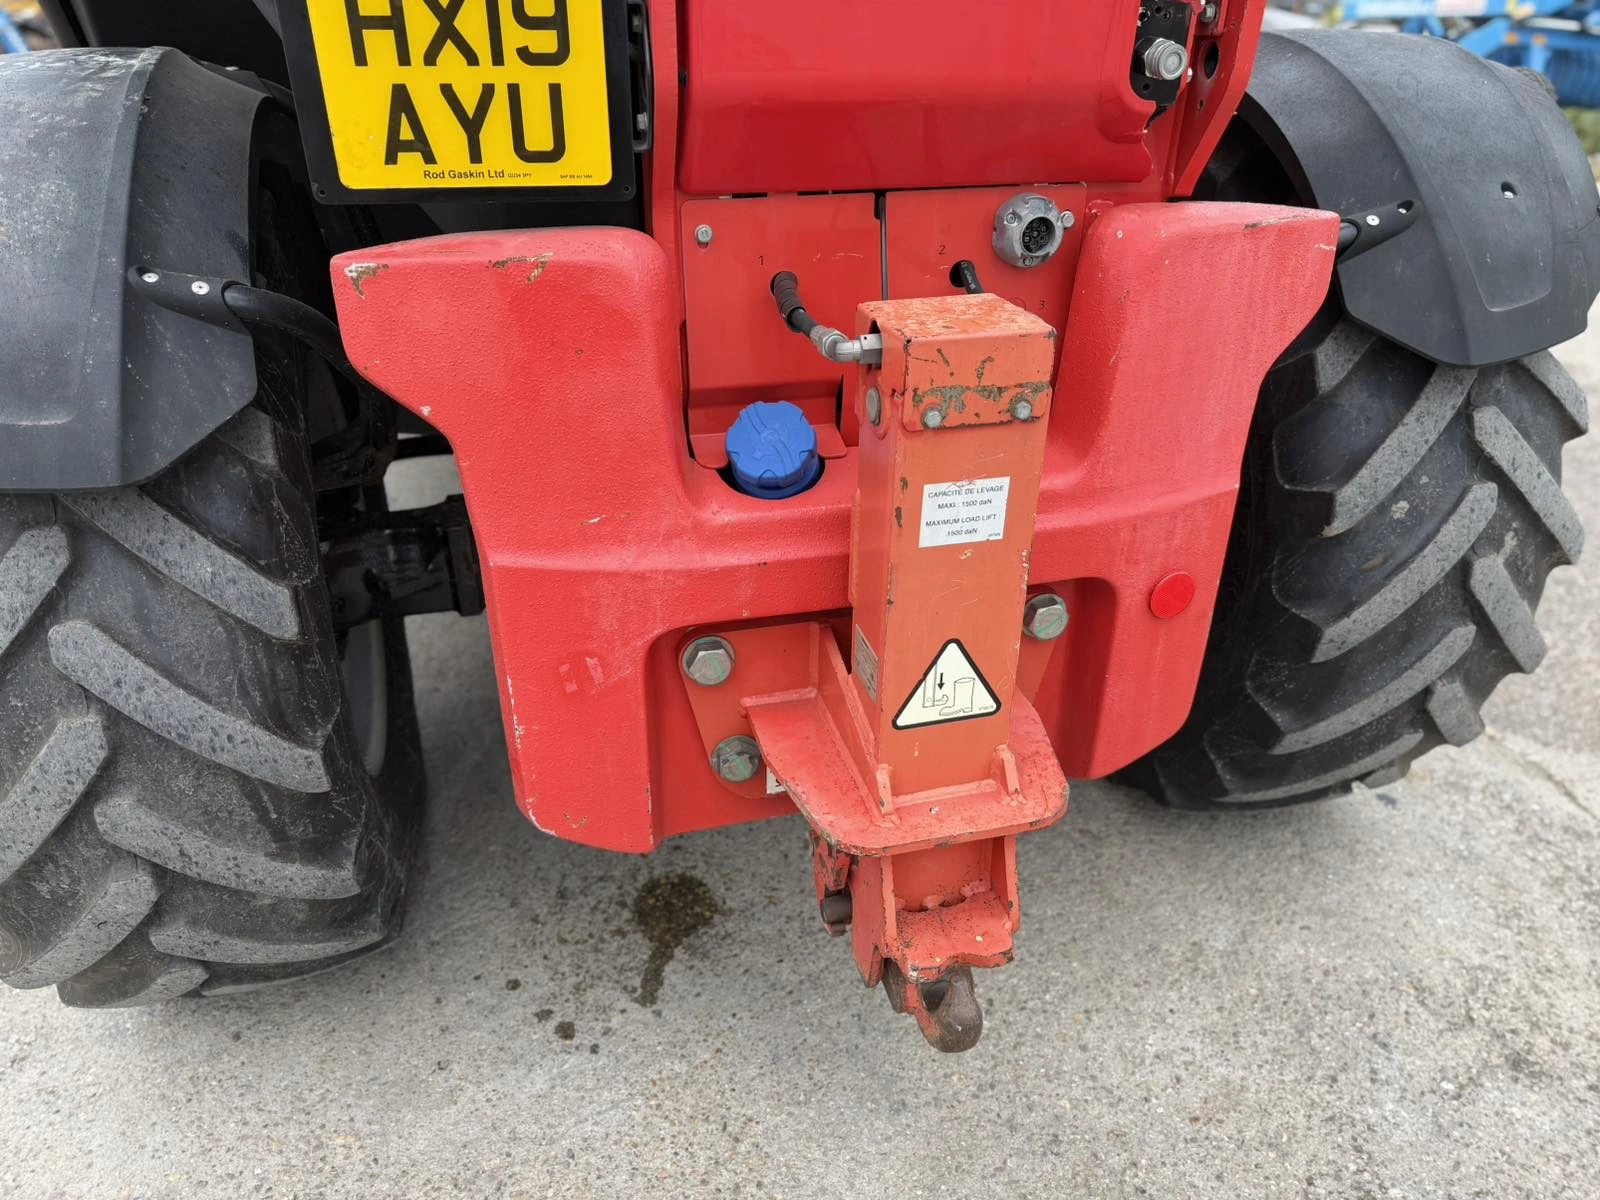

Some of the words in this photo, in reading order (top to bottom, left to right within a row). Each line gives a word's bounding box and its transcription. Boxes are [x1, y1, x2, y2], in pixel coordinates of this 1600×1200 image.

[345, 0, 571, 67] HX19
[384, 83, 566, 165] AYU
[423, 169, 445, 179] Rod
[448, 169, 485, 179] Gaskin
[487, 169, 505, 178] Ltd
[938, 244, 946, 255] 2
[758, 255, 764, 265] 1
[1039, 300, 1046, 310] 3
[964, 487, 975, 495] DE
[976, 484, 1004, 494] LEVAGE
[962, 499, 977, 507] 1500
[925, 517, 960, 527] MAXIMUM
[961, 515, 981, 523] LOAD
[982, 513, 997, 521] LIFT
[964, 527, 978, 535] daN
